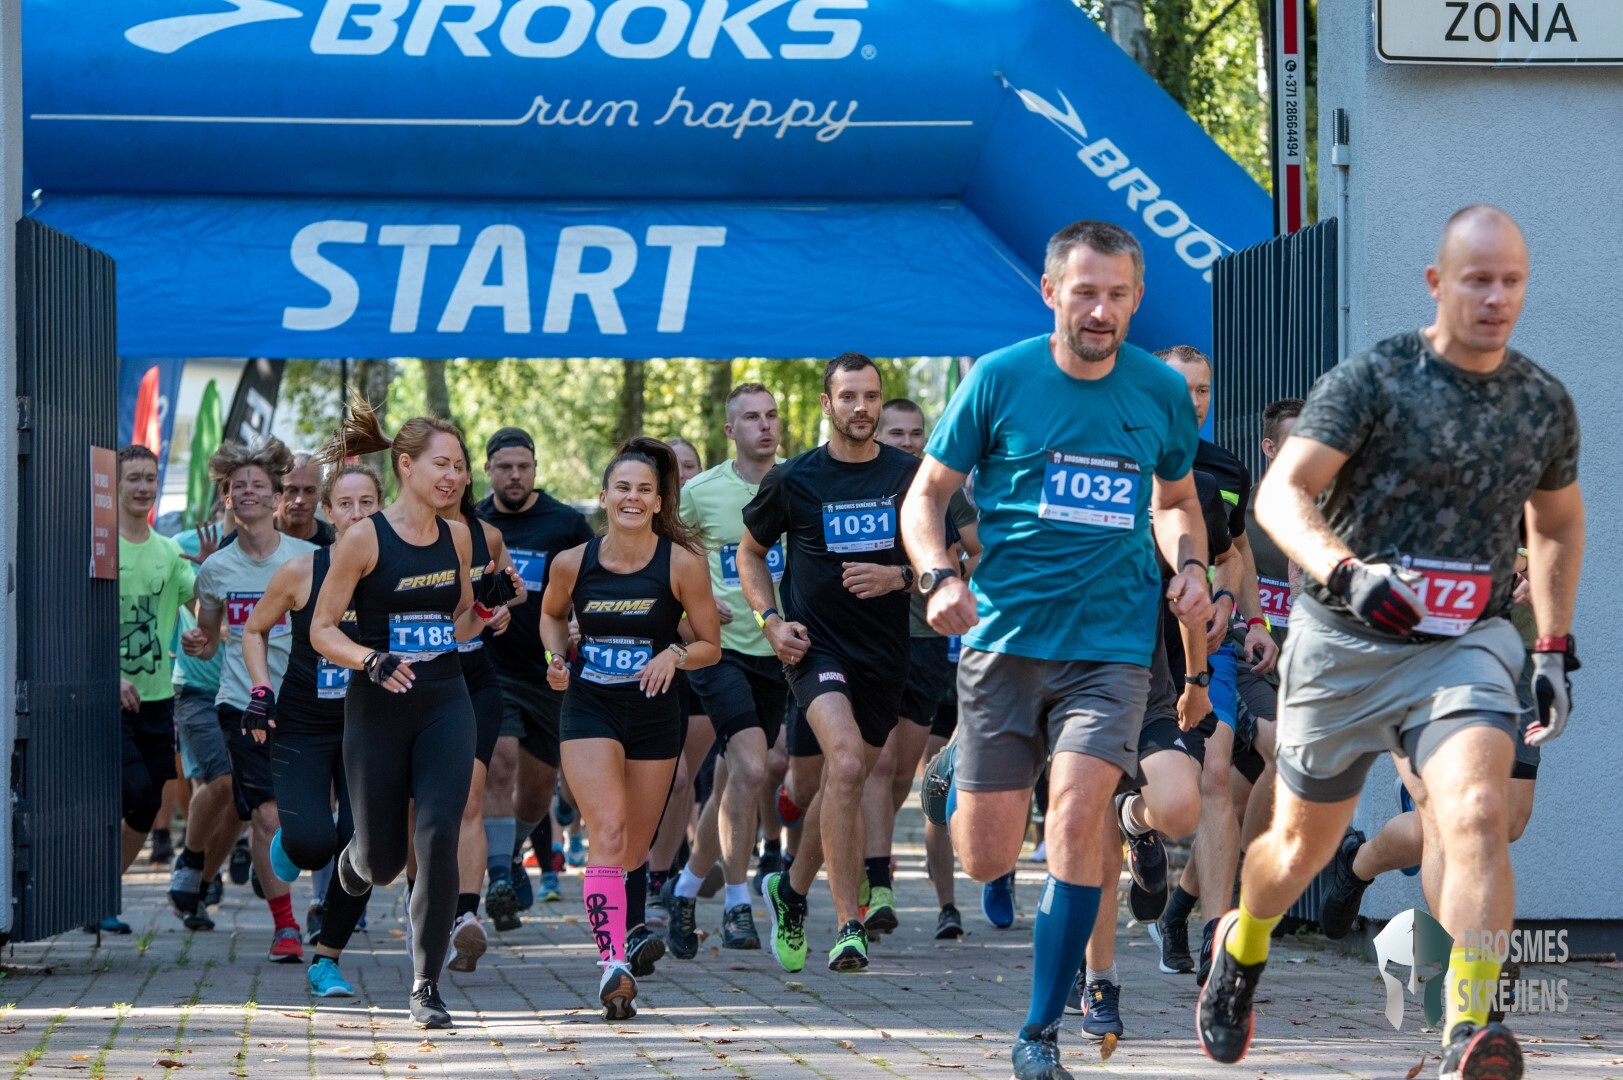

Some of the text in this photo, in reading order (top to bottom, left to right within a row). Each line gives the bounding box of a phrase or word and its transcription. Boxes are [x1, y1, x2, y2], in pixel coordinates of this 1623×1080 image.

[310, 0, 868, 60] BROOKS
[1445, 1, 1578, 43] ZONA
[522, 87, 858, 142] run happy
[1286, 74, 1298, 157] +371 28664494
[1077, 137, 1222, 283] BROO
[282, 220, 727, 335] START
[1050, 470, 1133, 505] 1032
[829, 512, 889, 536] 1031
[725, 549, 780, 572] 19
[1411, 577, 1477, 609] 172
[229, 603, 254, 620] T1
[393, 626, 454, 646] T185
[584, 646, 649, 670] T182
[321, 668, 350, 686] T1
[819, 671, 846, 684] MARVEL
